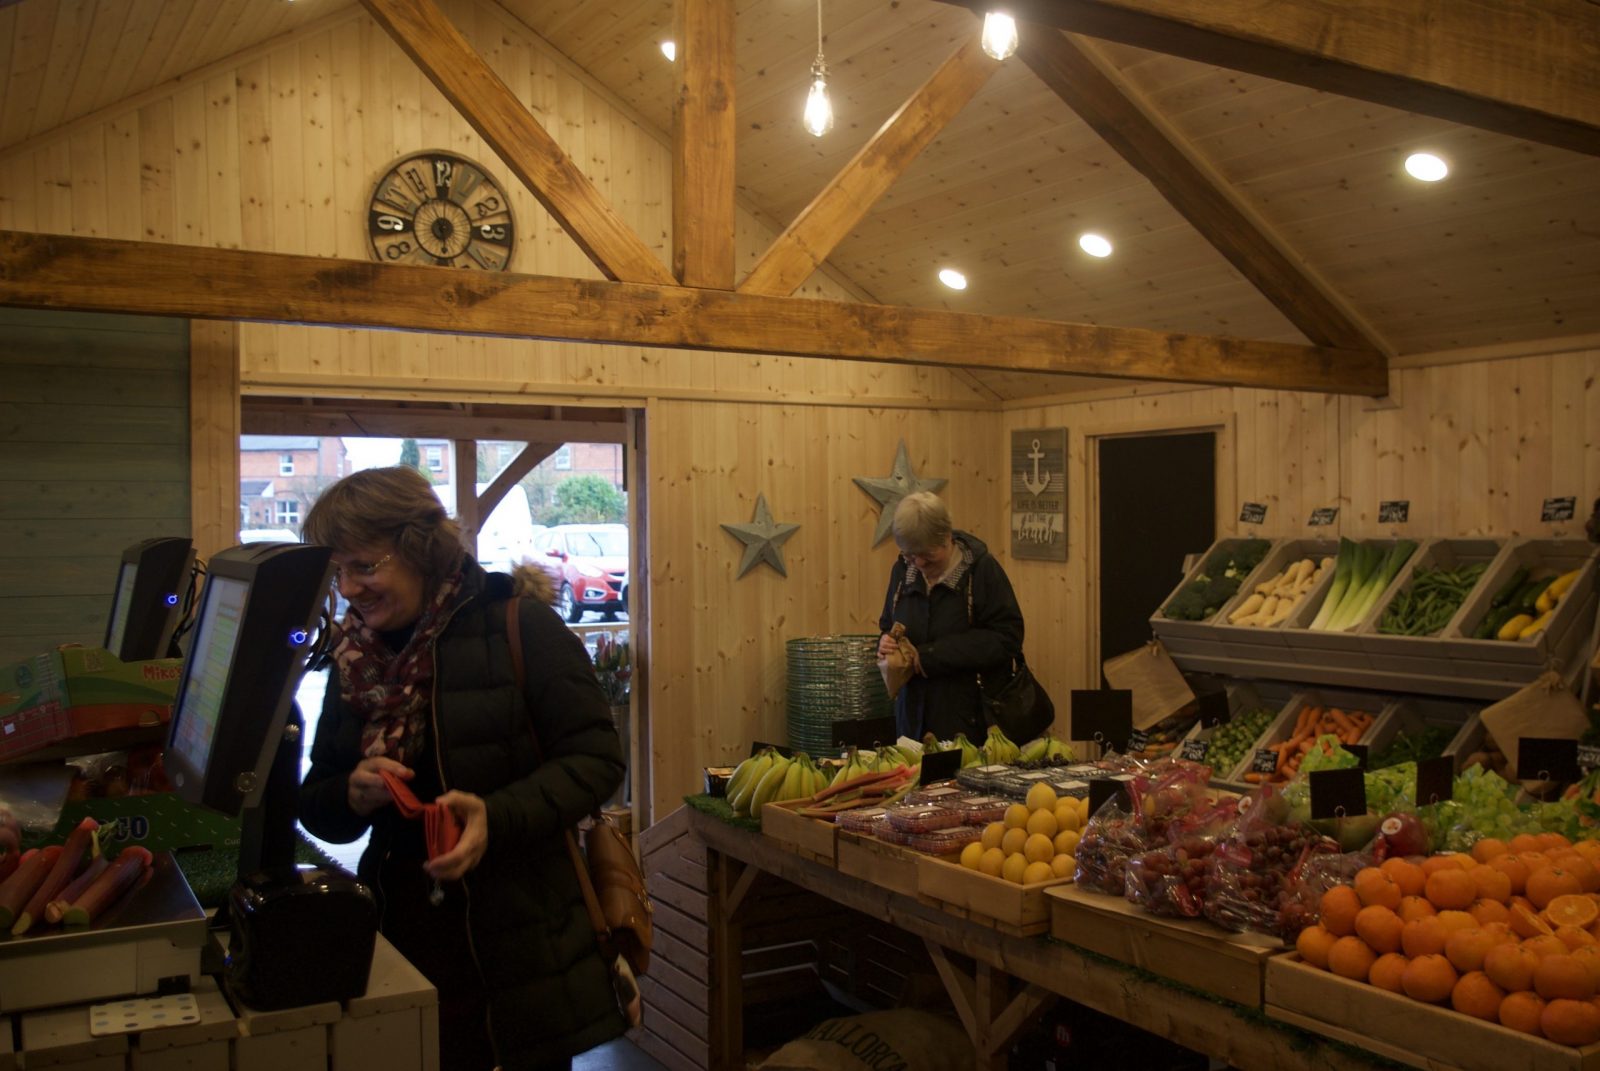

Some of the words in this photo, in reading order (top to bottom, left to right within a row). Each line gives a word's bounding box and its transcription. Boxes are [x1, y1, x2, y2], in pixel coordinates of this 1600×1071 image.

[434, 160, 452, 188] 12
[474, 196, 500, 218] 2
[480, 224, 505, 241] 3
[386, 241, 411, 260] 8
